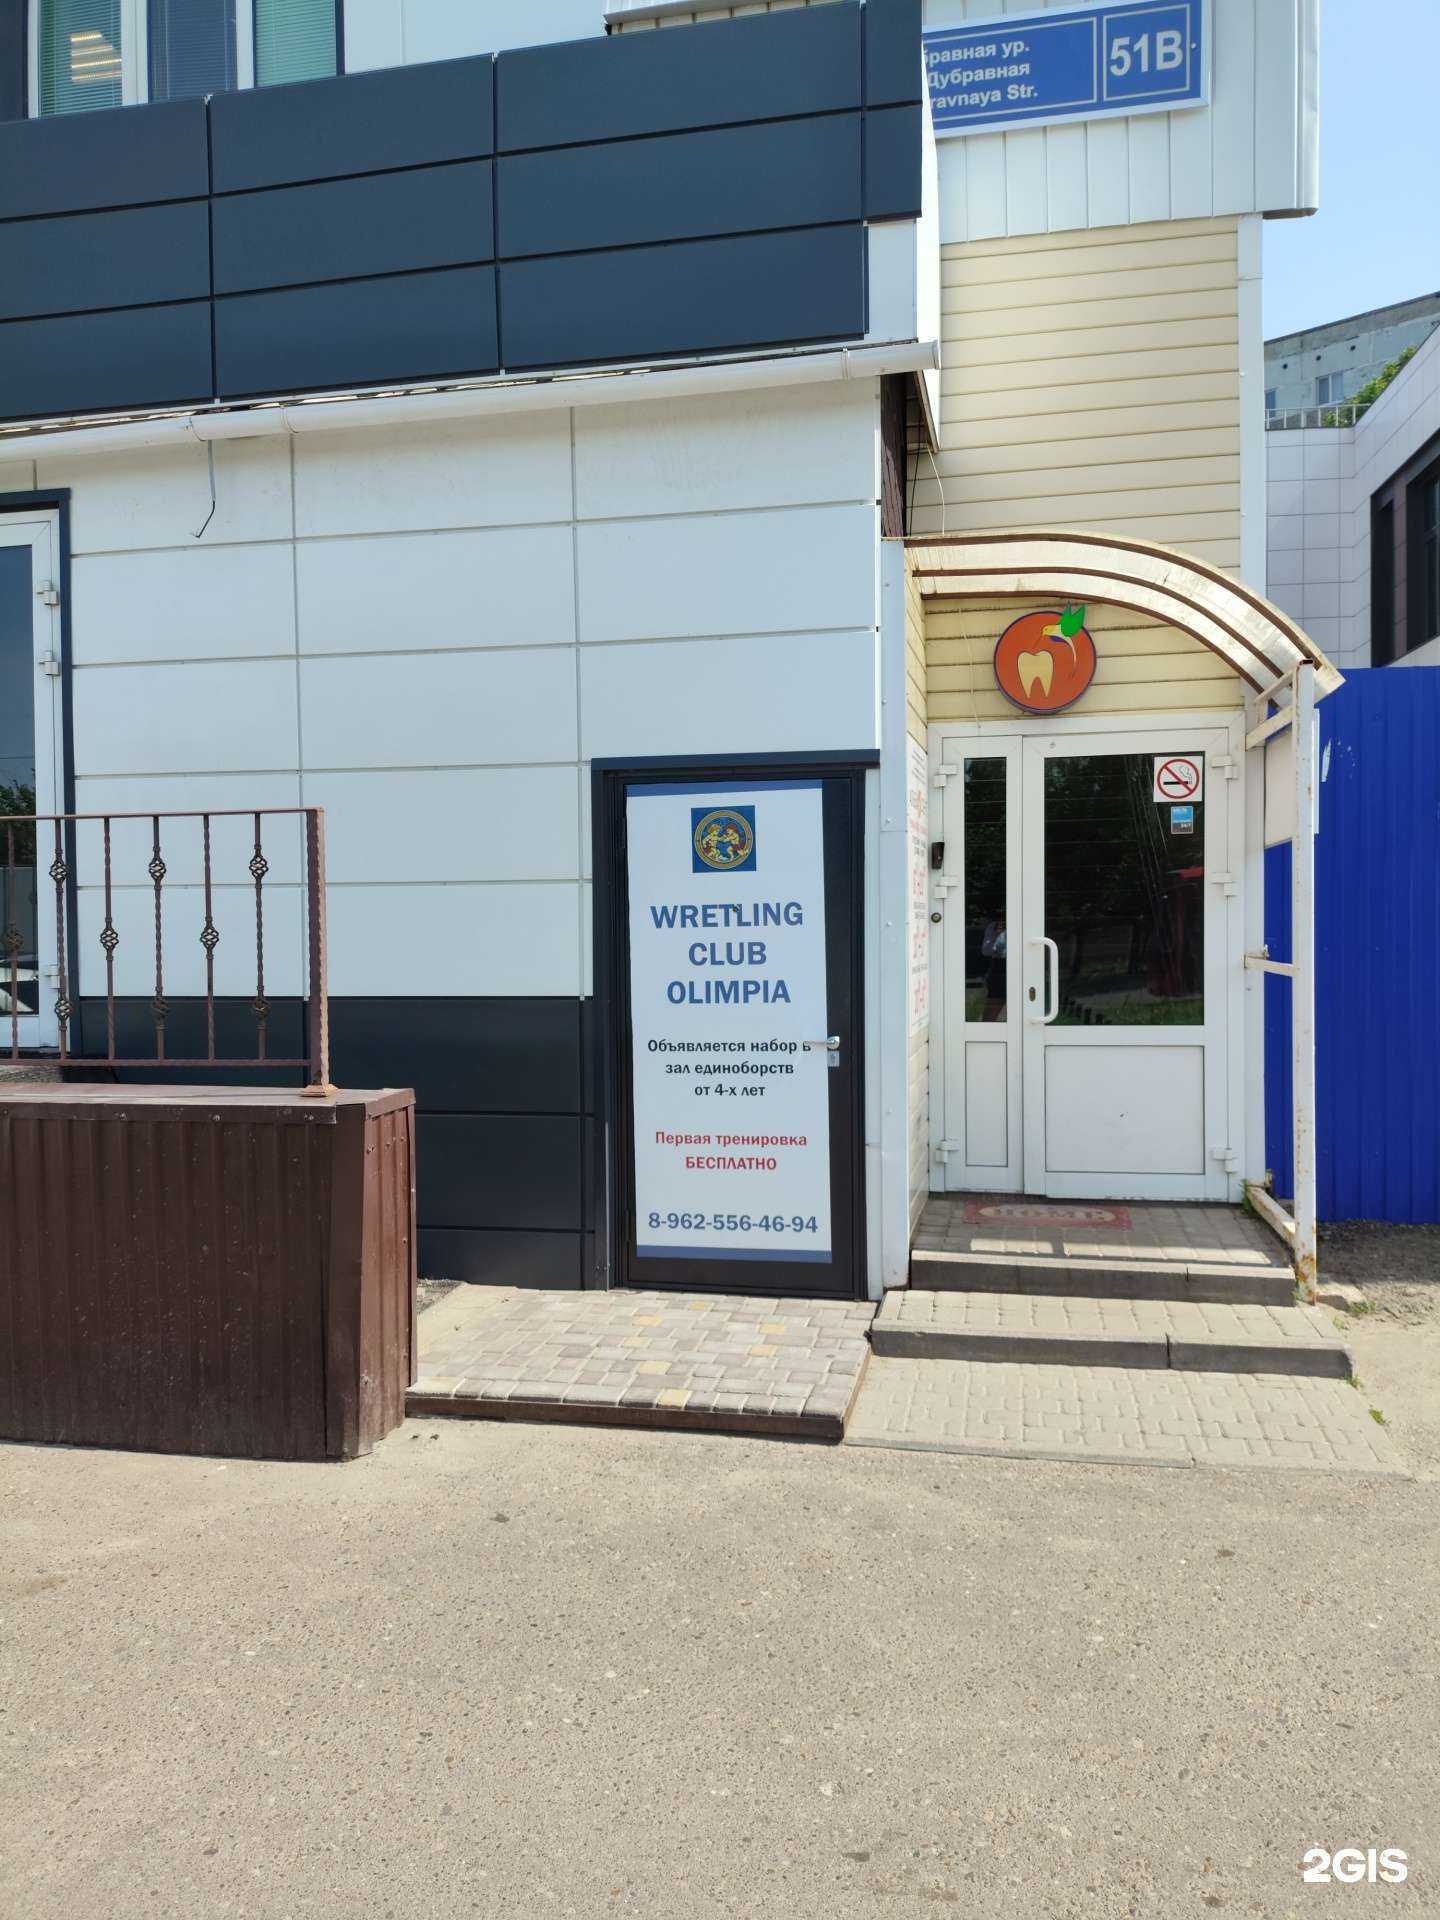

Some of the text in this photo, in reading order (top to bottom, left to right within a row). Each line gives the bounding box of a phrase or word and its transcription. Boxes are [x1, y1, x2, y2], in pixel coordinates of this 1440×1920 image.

[1001, 40, 1030, 59] ур.
[1109, 30, 1184, 77] 51В
[927, 63, 1031, 90] Дубравная
[1006, 84, 1039, 101] Str.
[650, 901, 804, 929] WRETLING
[688, 941, 768, 967] CLUB
[666, 979, 792, 1005] OLIMPIA
[647, 1038, 746, 1053] Объявляется
[750, 1038, 798, 1055] набор
[665, 1061, 795, 1077] зал единоборств
[694, 1083, 766, 1097] от 4-х лет
[655, 1131, 808, 1148] Первая тренировка
[685, 1156, 778, 1171] БЕСПЛАТНО
[648, 1212, 819, 1234] 8-962-556-46-94
